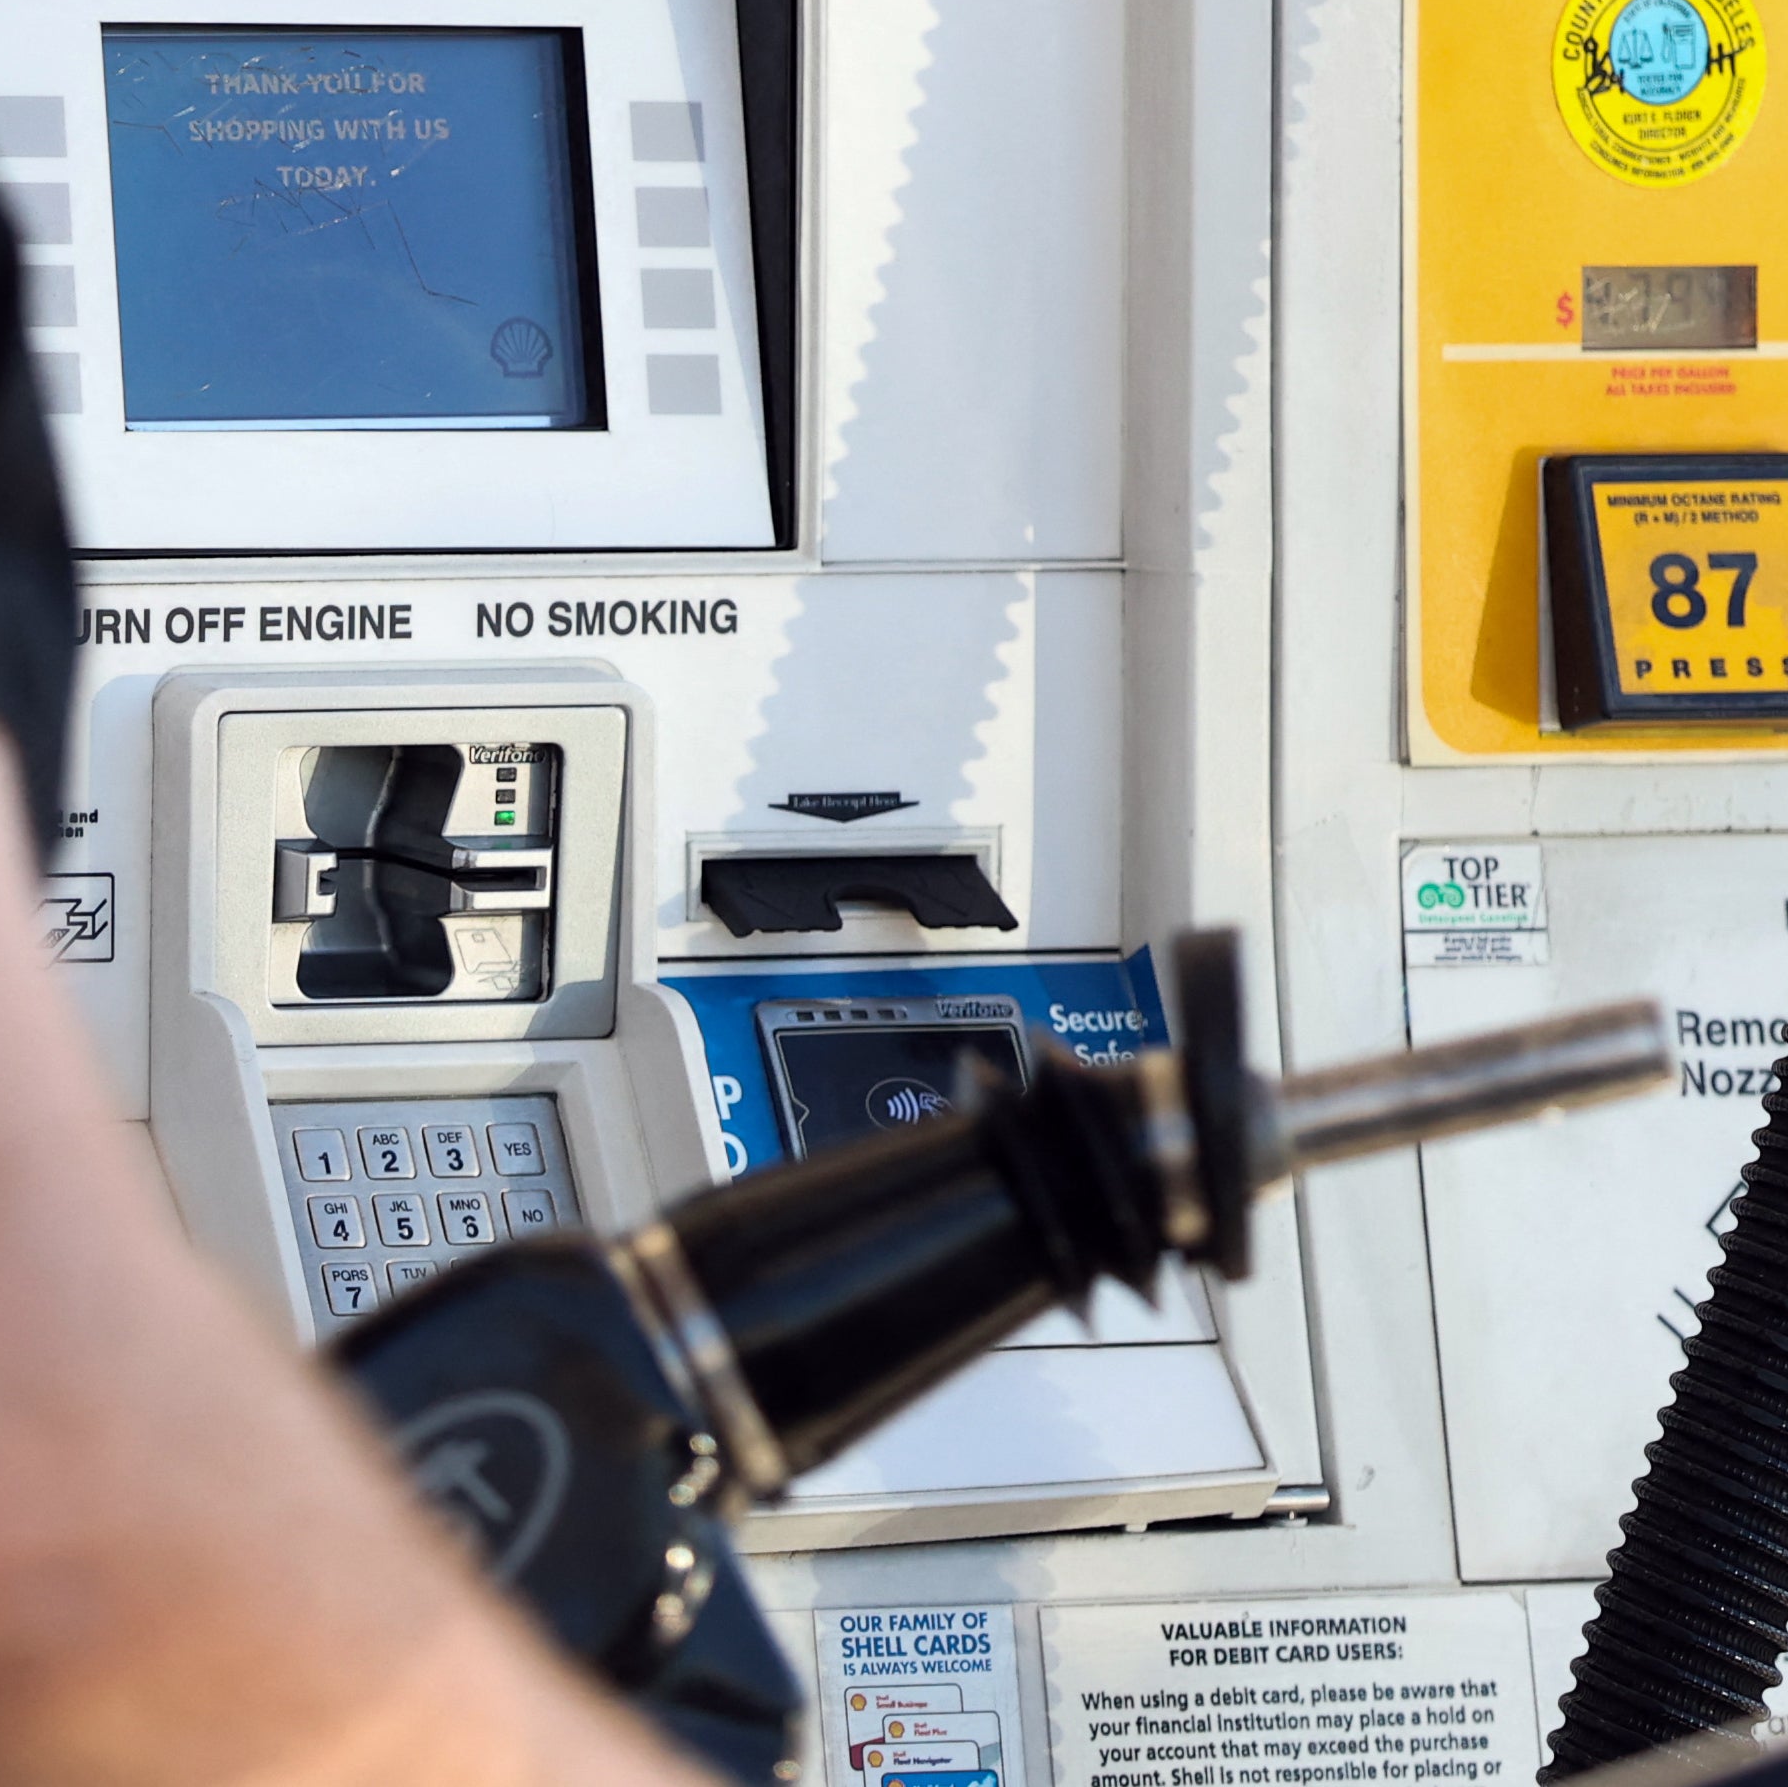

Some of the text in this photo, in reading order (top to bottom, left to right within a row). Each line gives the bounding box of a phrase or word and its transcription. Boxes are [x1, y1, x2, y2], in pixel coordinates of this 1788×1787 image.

[205, 72, 425, 95] THANK YOU FOR
[189, 118, 450, 142] SHOPPING WITH US
[277, 165, 377, 187] TODAY.
[1557, 292, 1574, 329] $
[1612, 366, 1729, 379] PRICE PER GALLON
[1606, 385, 1626, 396] ALL
[1607, 492, 1781, 507] MINIMUM OCTANE RATING
[1701, 510, 1759, 524] METHOD
[1649, 552, 1758, 630] 87
[74, 599, 739, 646] URN OFF ENGINE NO SMOKING
[792, 794, 898, 811] Take Receipt Here
[69, 809, 99, 823] and
[1443, 856, 1499, 881] TOP
[1468, 883, 1527, 909] TIER
[1676, 1011, 1787, 1048] Remo
[1681, 1062, 1776, 1096] Nozz
[372, 1133, 399, 1145] ABC
[437, 1131, 462, 1144] DEF
[446, 1148, 464, 1171] 3
[503, 1142, 532, 1157] YES
[318, 1152, 331, 1175] 1
[382, 1150, 399, 1173] 2
[324, 1203, 348, 1214] GHI
[389, 1200, 412, 1213] JKL
[449, 1198, 480, 1211] MNO
[462, 1215, 479, 1238] 6
[522, 1209, 544, 1223] NO
[333, 1219, 349, 1241] 4
[397, 1217, 414, 1240] 5
[332, 1270, 369, 1282] PQRS
[401, 1267, 427, 1280] TUV
[345, 1286, 361, 1309] 7
[840, 1612, 988, 1633] OUR FAMILY OF
[1161, 1616, 1407, 1640] VALUABLE INFORMATION
[842, 1633, 991, 1659] SHELL CARDS
[1169, 1642, 1403, 1667] FOR DEBIT CARD USERS:
[843, 1659, 992, 1676] IS ALWAYS WELCOME
[876, 1701, 896, 1709] Small
[1081, 1679, 1498, 1712] When using a debit card, please be aware that
[914, 1728, 948, 1737] Fleet Plus
[1089, 1705, 1495, 1742] your financial institution may place a hold on
[1099, 1732, 1489, 1767] your account that may exceed the purchase
[893, 1757, 953, 1767] Fleet Navigator
[1090, 1760, 1502, 1787] amount. Shell is not responsible for placing or
